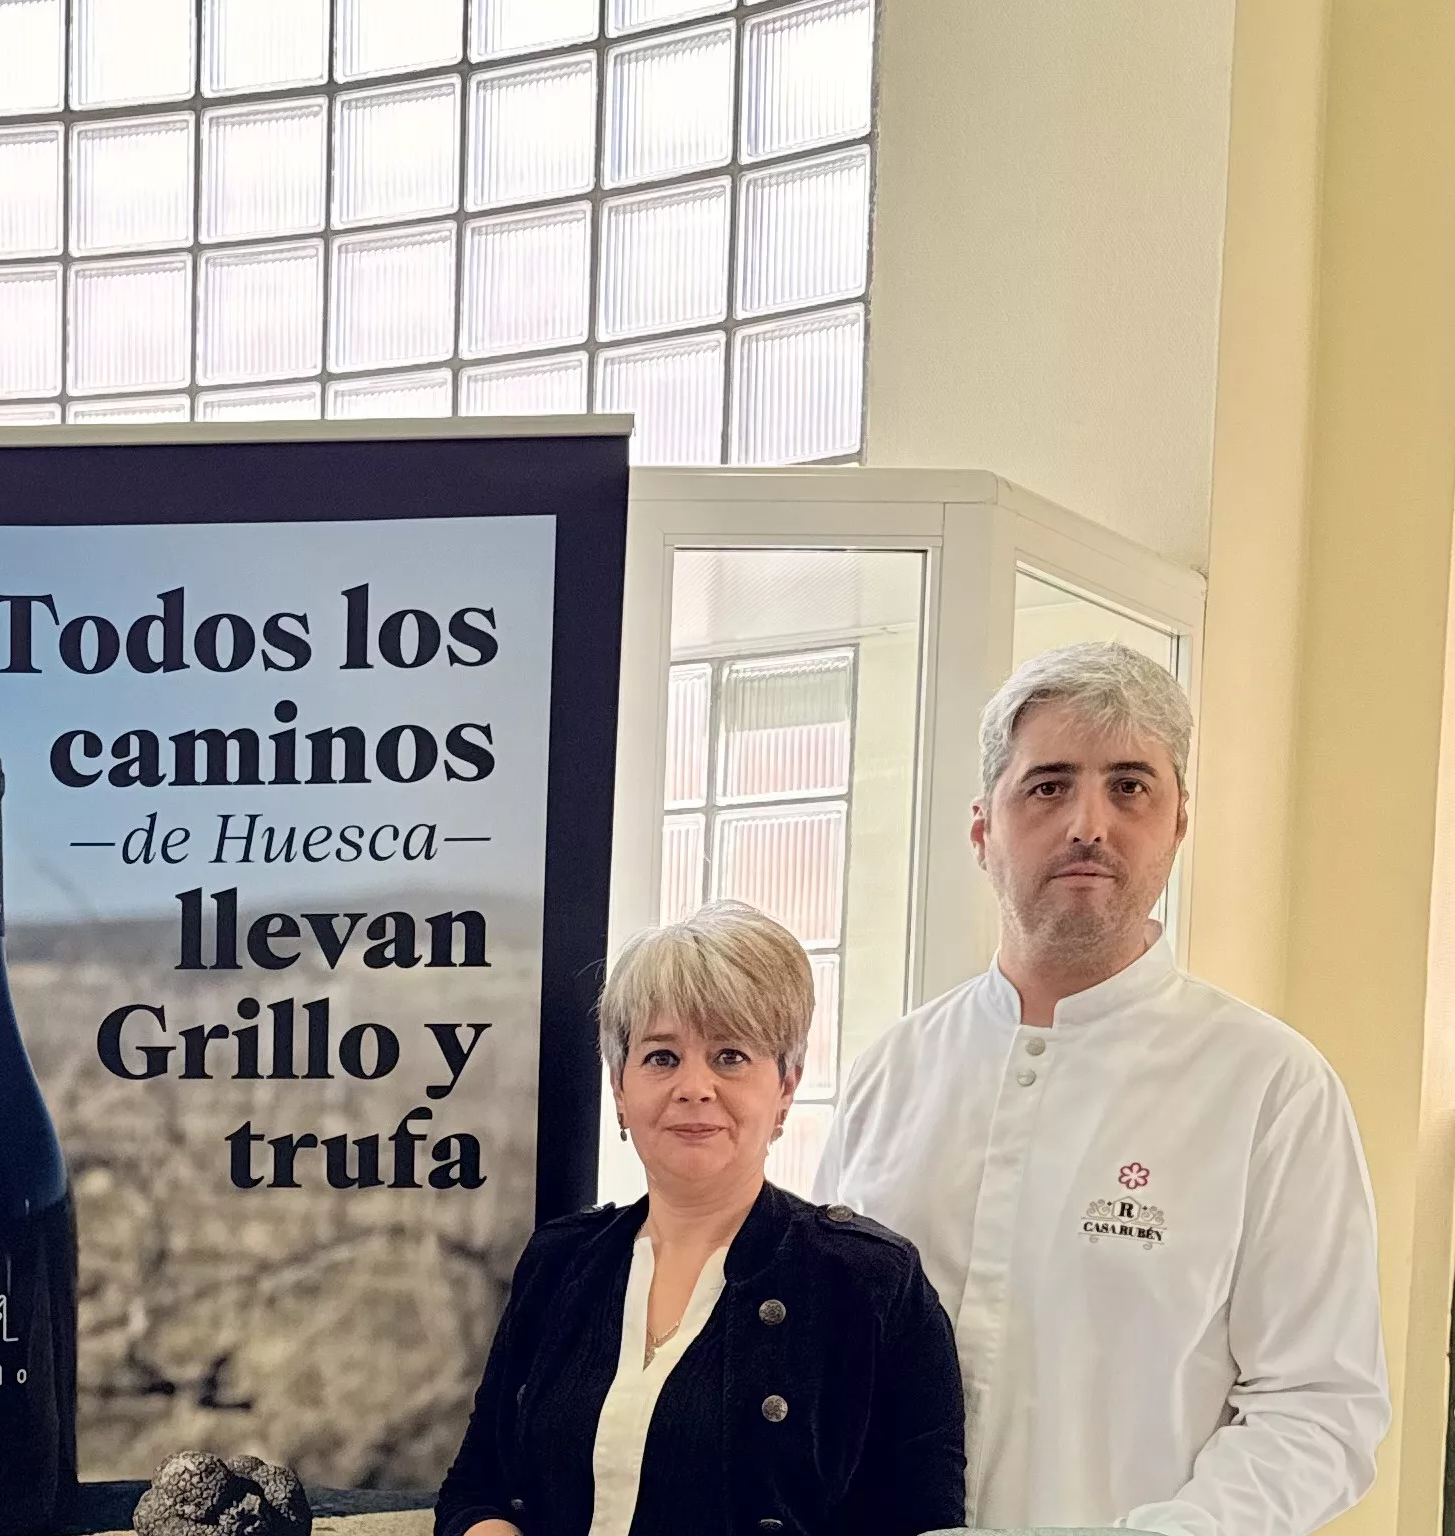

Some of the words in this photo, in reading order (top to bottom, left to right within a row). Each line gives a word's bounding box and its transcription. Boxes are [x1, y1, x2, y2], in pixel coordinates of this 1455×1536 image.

[339, 582, 499, 670] los
[49, 699, 495, 788] caminos
[174, 886, 492, 971] llevan
[96, 997, 400, 1081] Grillo
[424, 1023, 493, 1100] y
[224, 1106, 488, 1190] trufa
[1083, 1221, 1117, 1236] CASA
[1117, 1201, 1135, 1219] R
